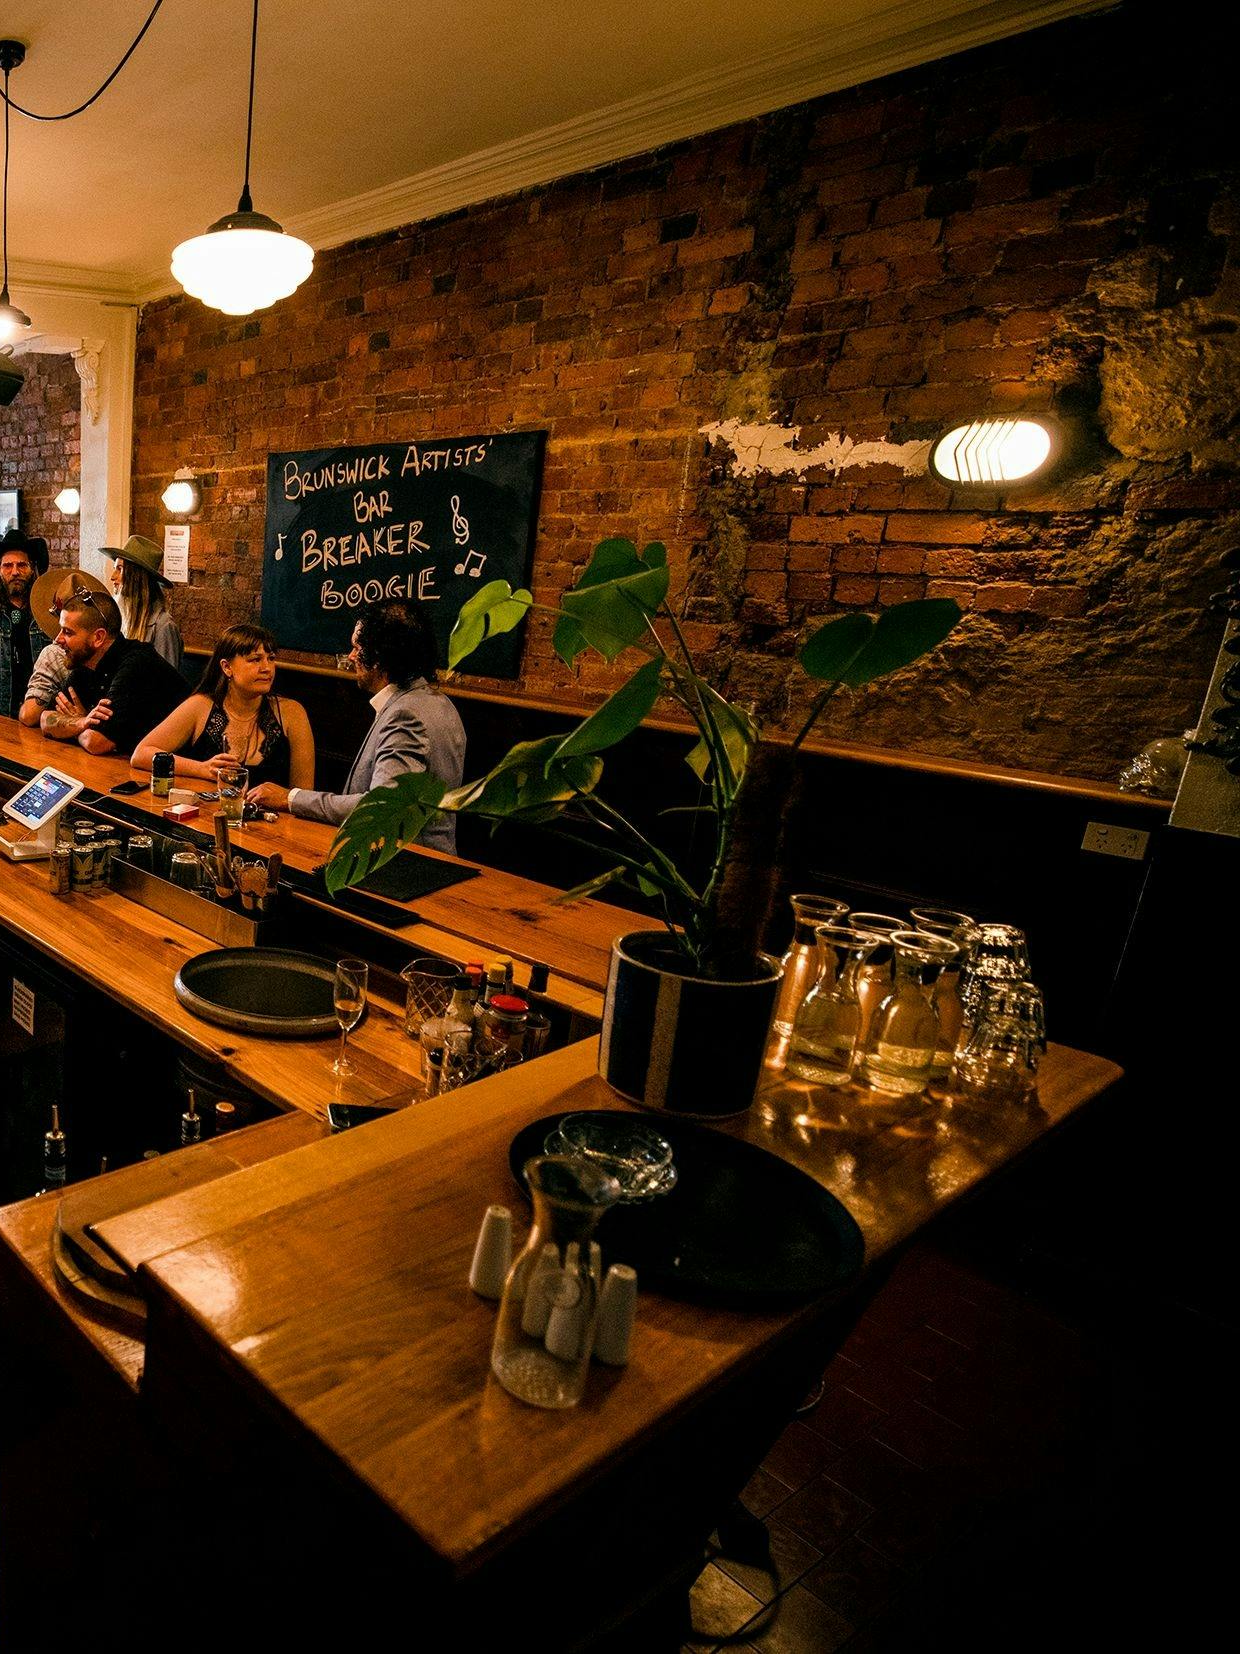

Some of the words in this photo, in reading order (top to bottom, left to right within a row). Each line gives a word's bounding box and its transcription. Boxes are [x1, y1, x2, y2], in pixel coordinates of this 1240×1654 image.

[283, 454, 390, 500] BRUNSWICK
[401, 438, 493, 477] ARTISTS'
[353, 490, 393, 523] BAR
[301, 520, 431, 573] BREAKER
[320, 566, 441, 610] BOOGIE
